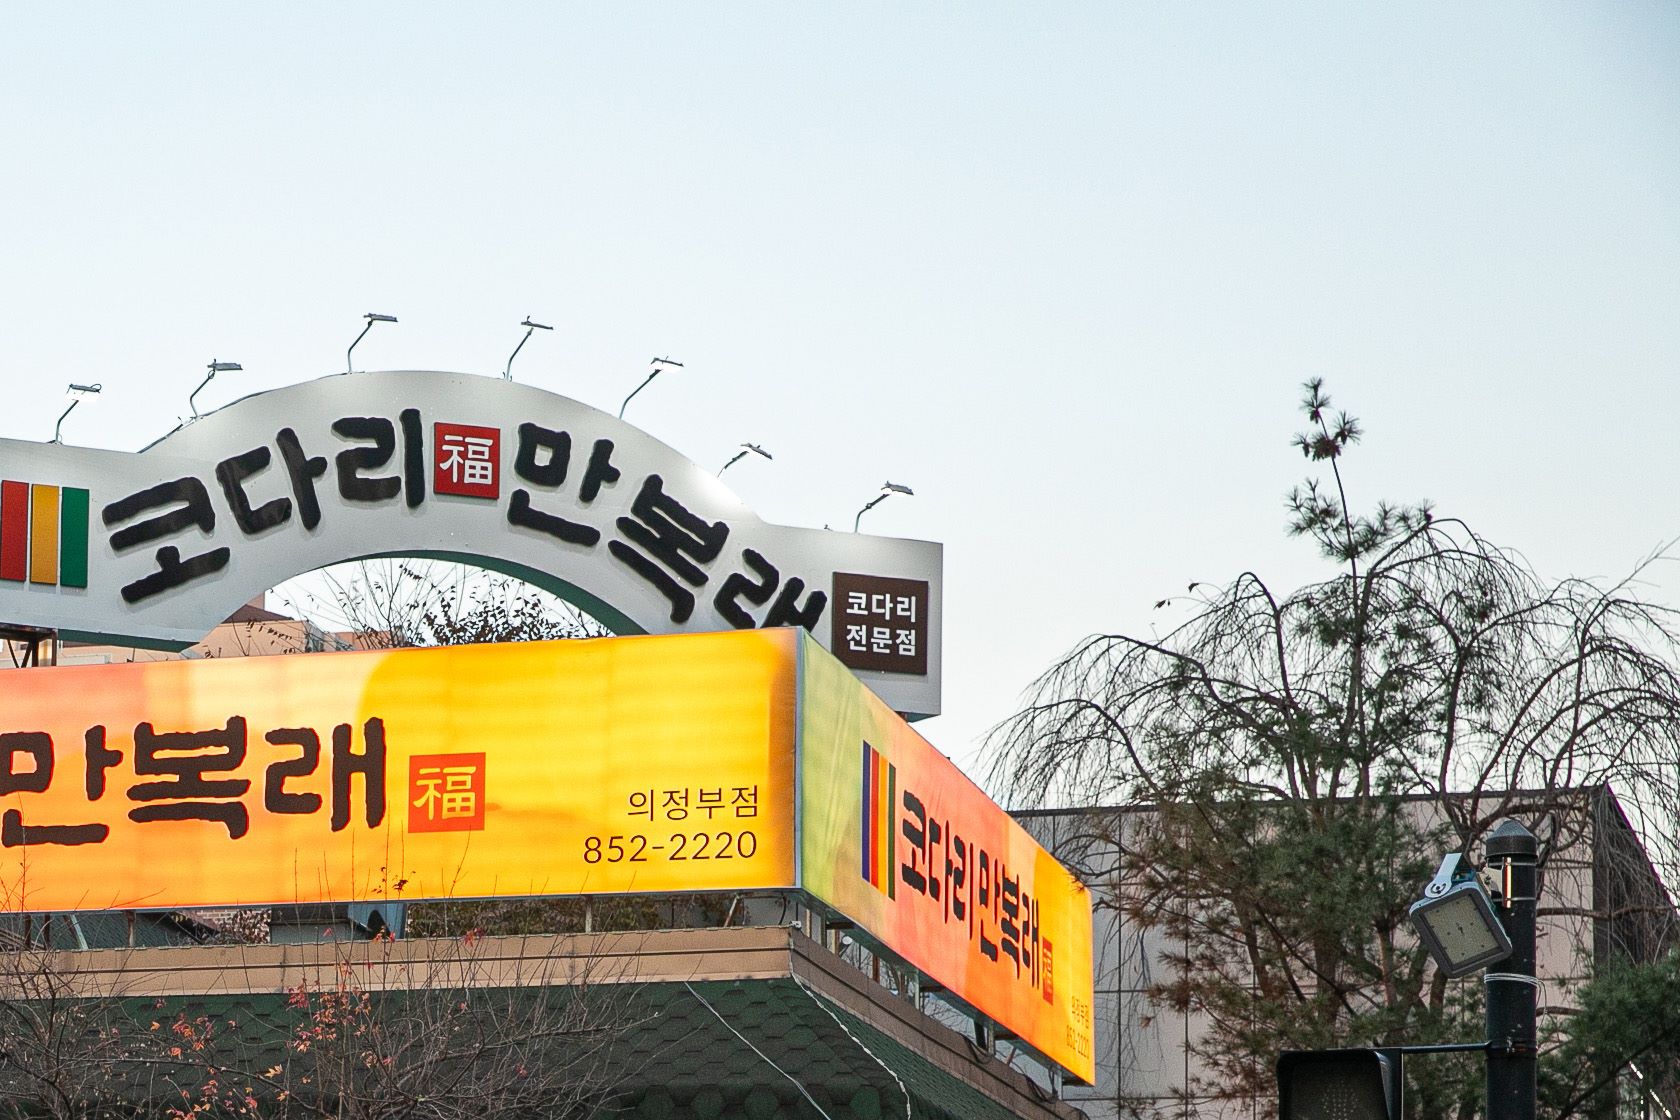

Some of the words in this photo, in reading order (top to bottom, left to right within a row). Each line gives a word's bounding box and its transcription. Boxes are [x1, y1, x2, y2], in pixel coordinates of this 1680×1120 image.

[102, 408, 426, 604] 코다리
[439, 434, 494, 486] 福
[506, 421, 828, 631] 만복래
[846, 591, 917, 623] 코다리
[845, 624, 916, 656] 전문점
[412, 765, 477, 822] 福
[627, 785, 759, 821] 의정부점
[583, 830, 758, 864] 852-2220
